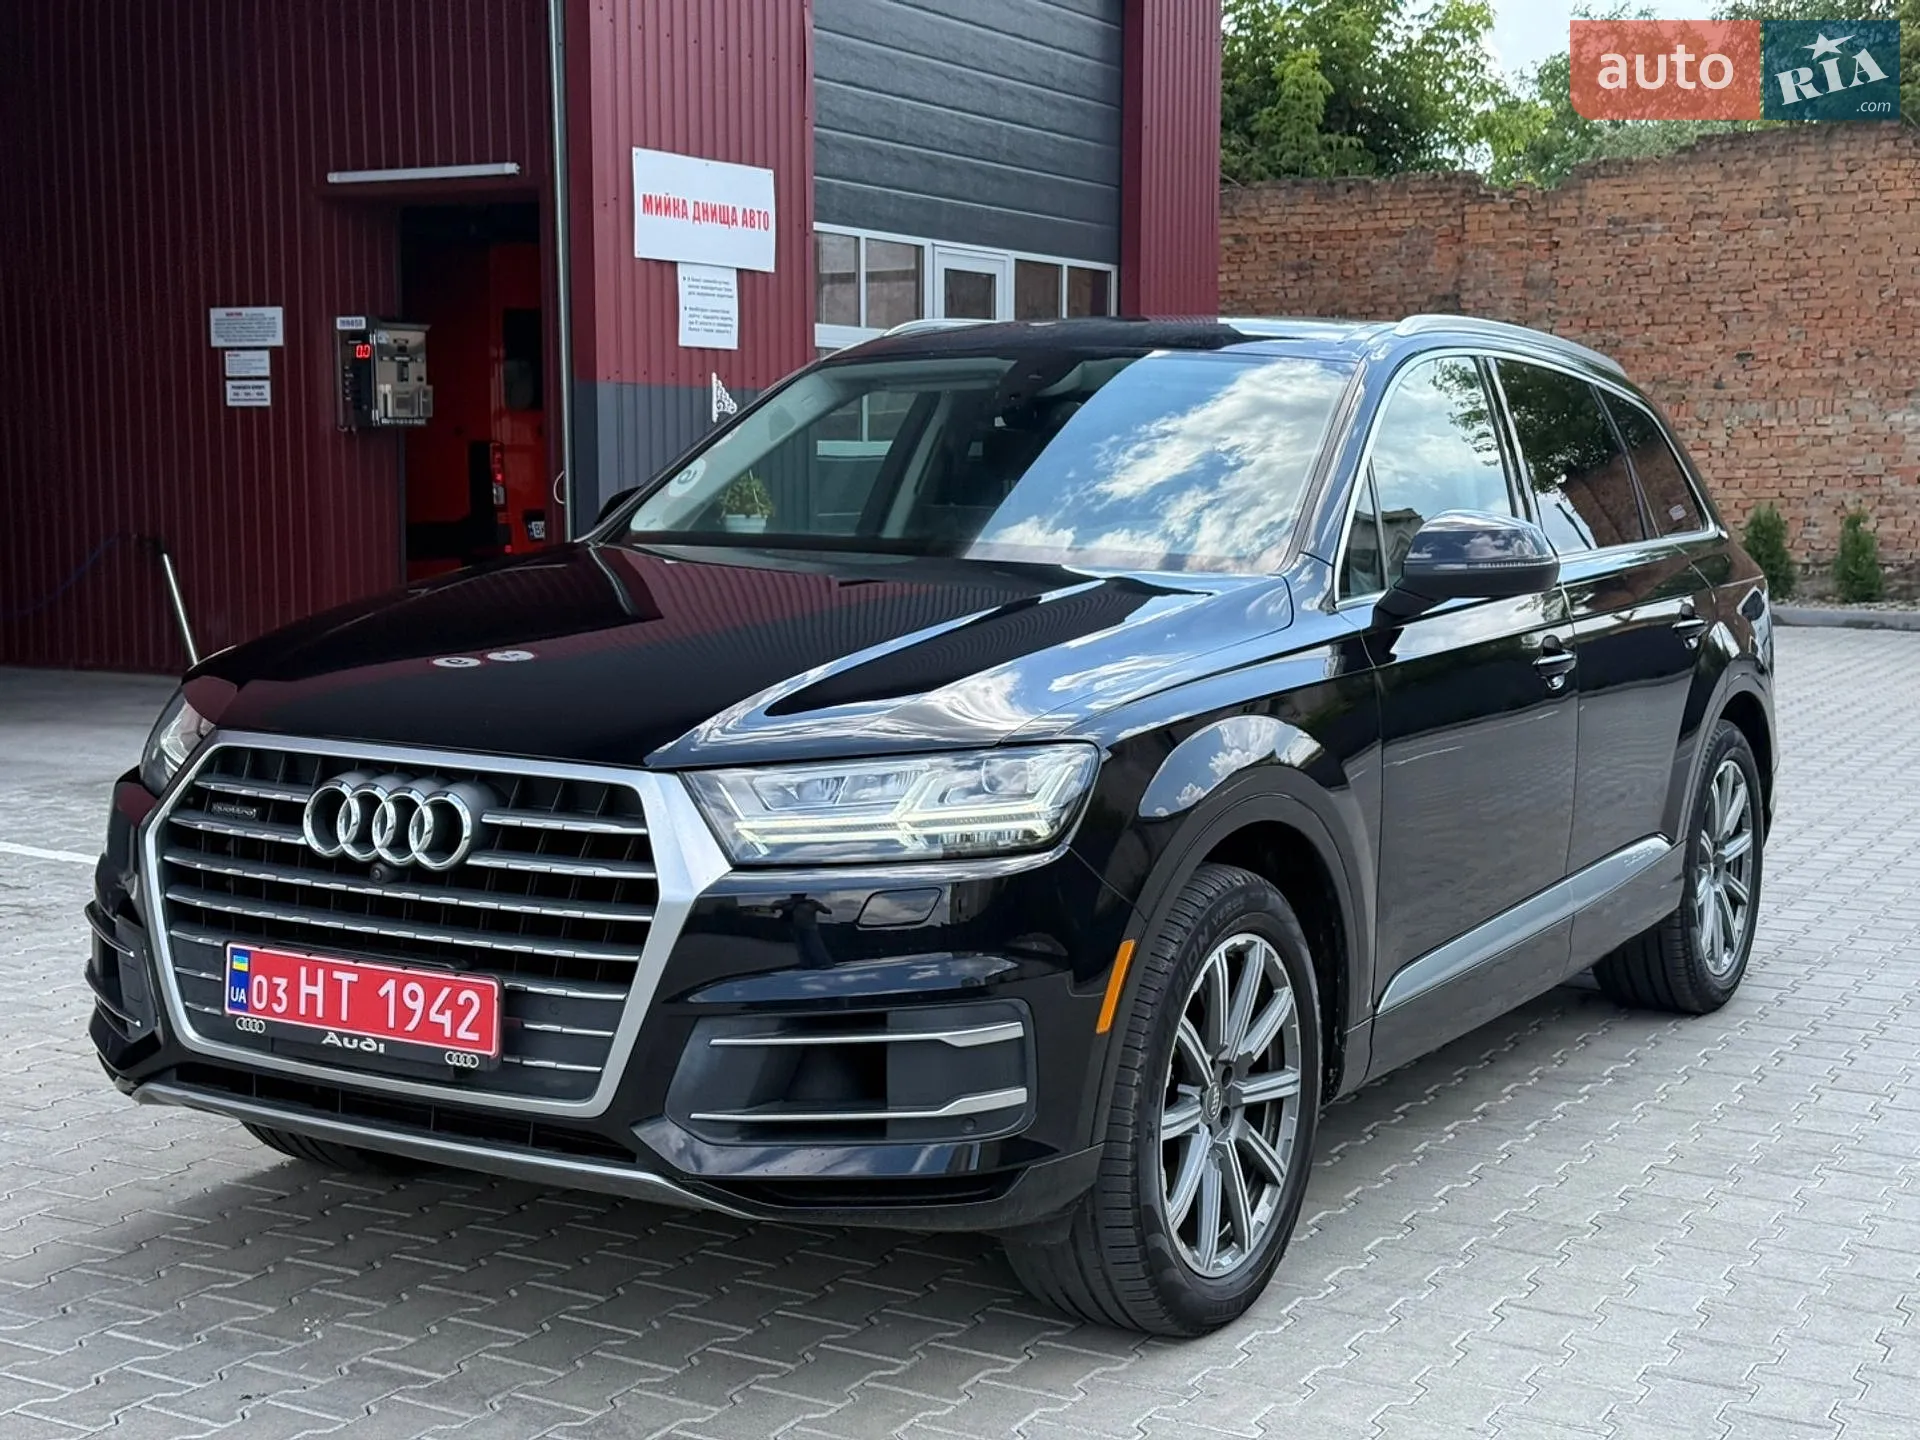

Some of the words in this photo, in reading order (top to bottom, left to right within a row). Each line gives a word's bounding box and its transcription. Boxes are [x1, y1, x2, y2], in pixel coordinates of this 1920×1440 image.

[642, 192, 689, 220] МИЙКА
[692, 200, 738, 230] ДНИЩА
[741, 207, 770, 232] АВТО
[230, 986, 247, 1004] UA
[252, 975, 289, 1014] 03
[299, 966, 359, 1022] HT
[377, 979, 481, 1042] 1942
[321, 1031, 385, 1054] Audi
